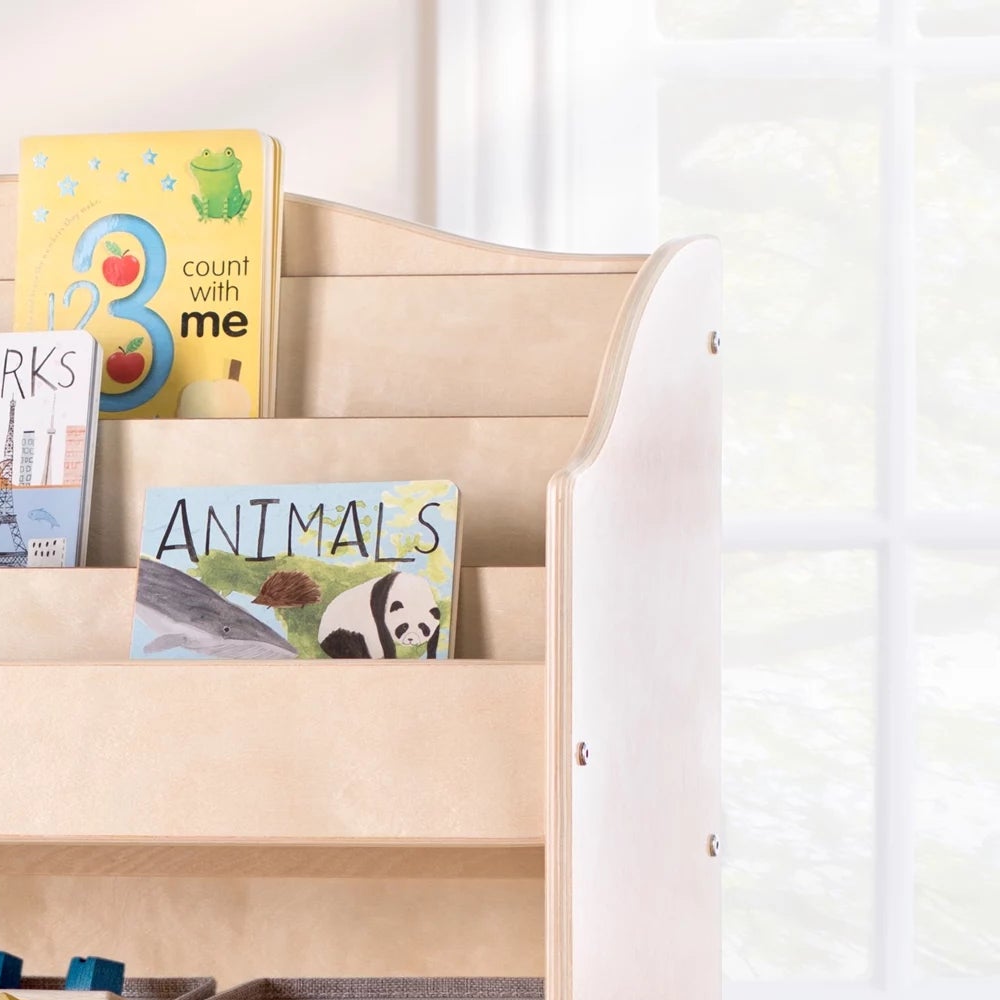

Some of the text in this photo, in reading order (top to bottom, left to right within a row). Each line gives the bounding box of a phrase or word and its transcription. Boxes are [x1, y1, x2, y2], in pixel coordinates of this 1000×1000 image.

[183, 256, 249, 277] count
[190, 280, 239, 302] with
[181, 310, 249, 338] me
[156, 498, 440, 563] ANIMALS
